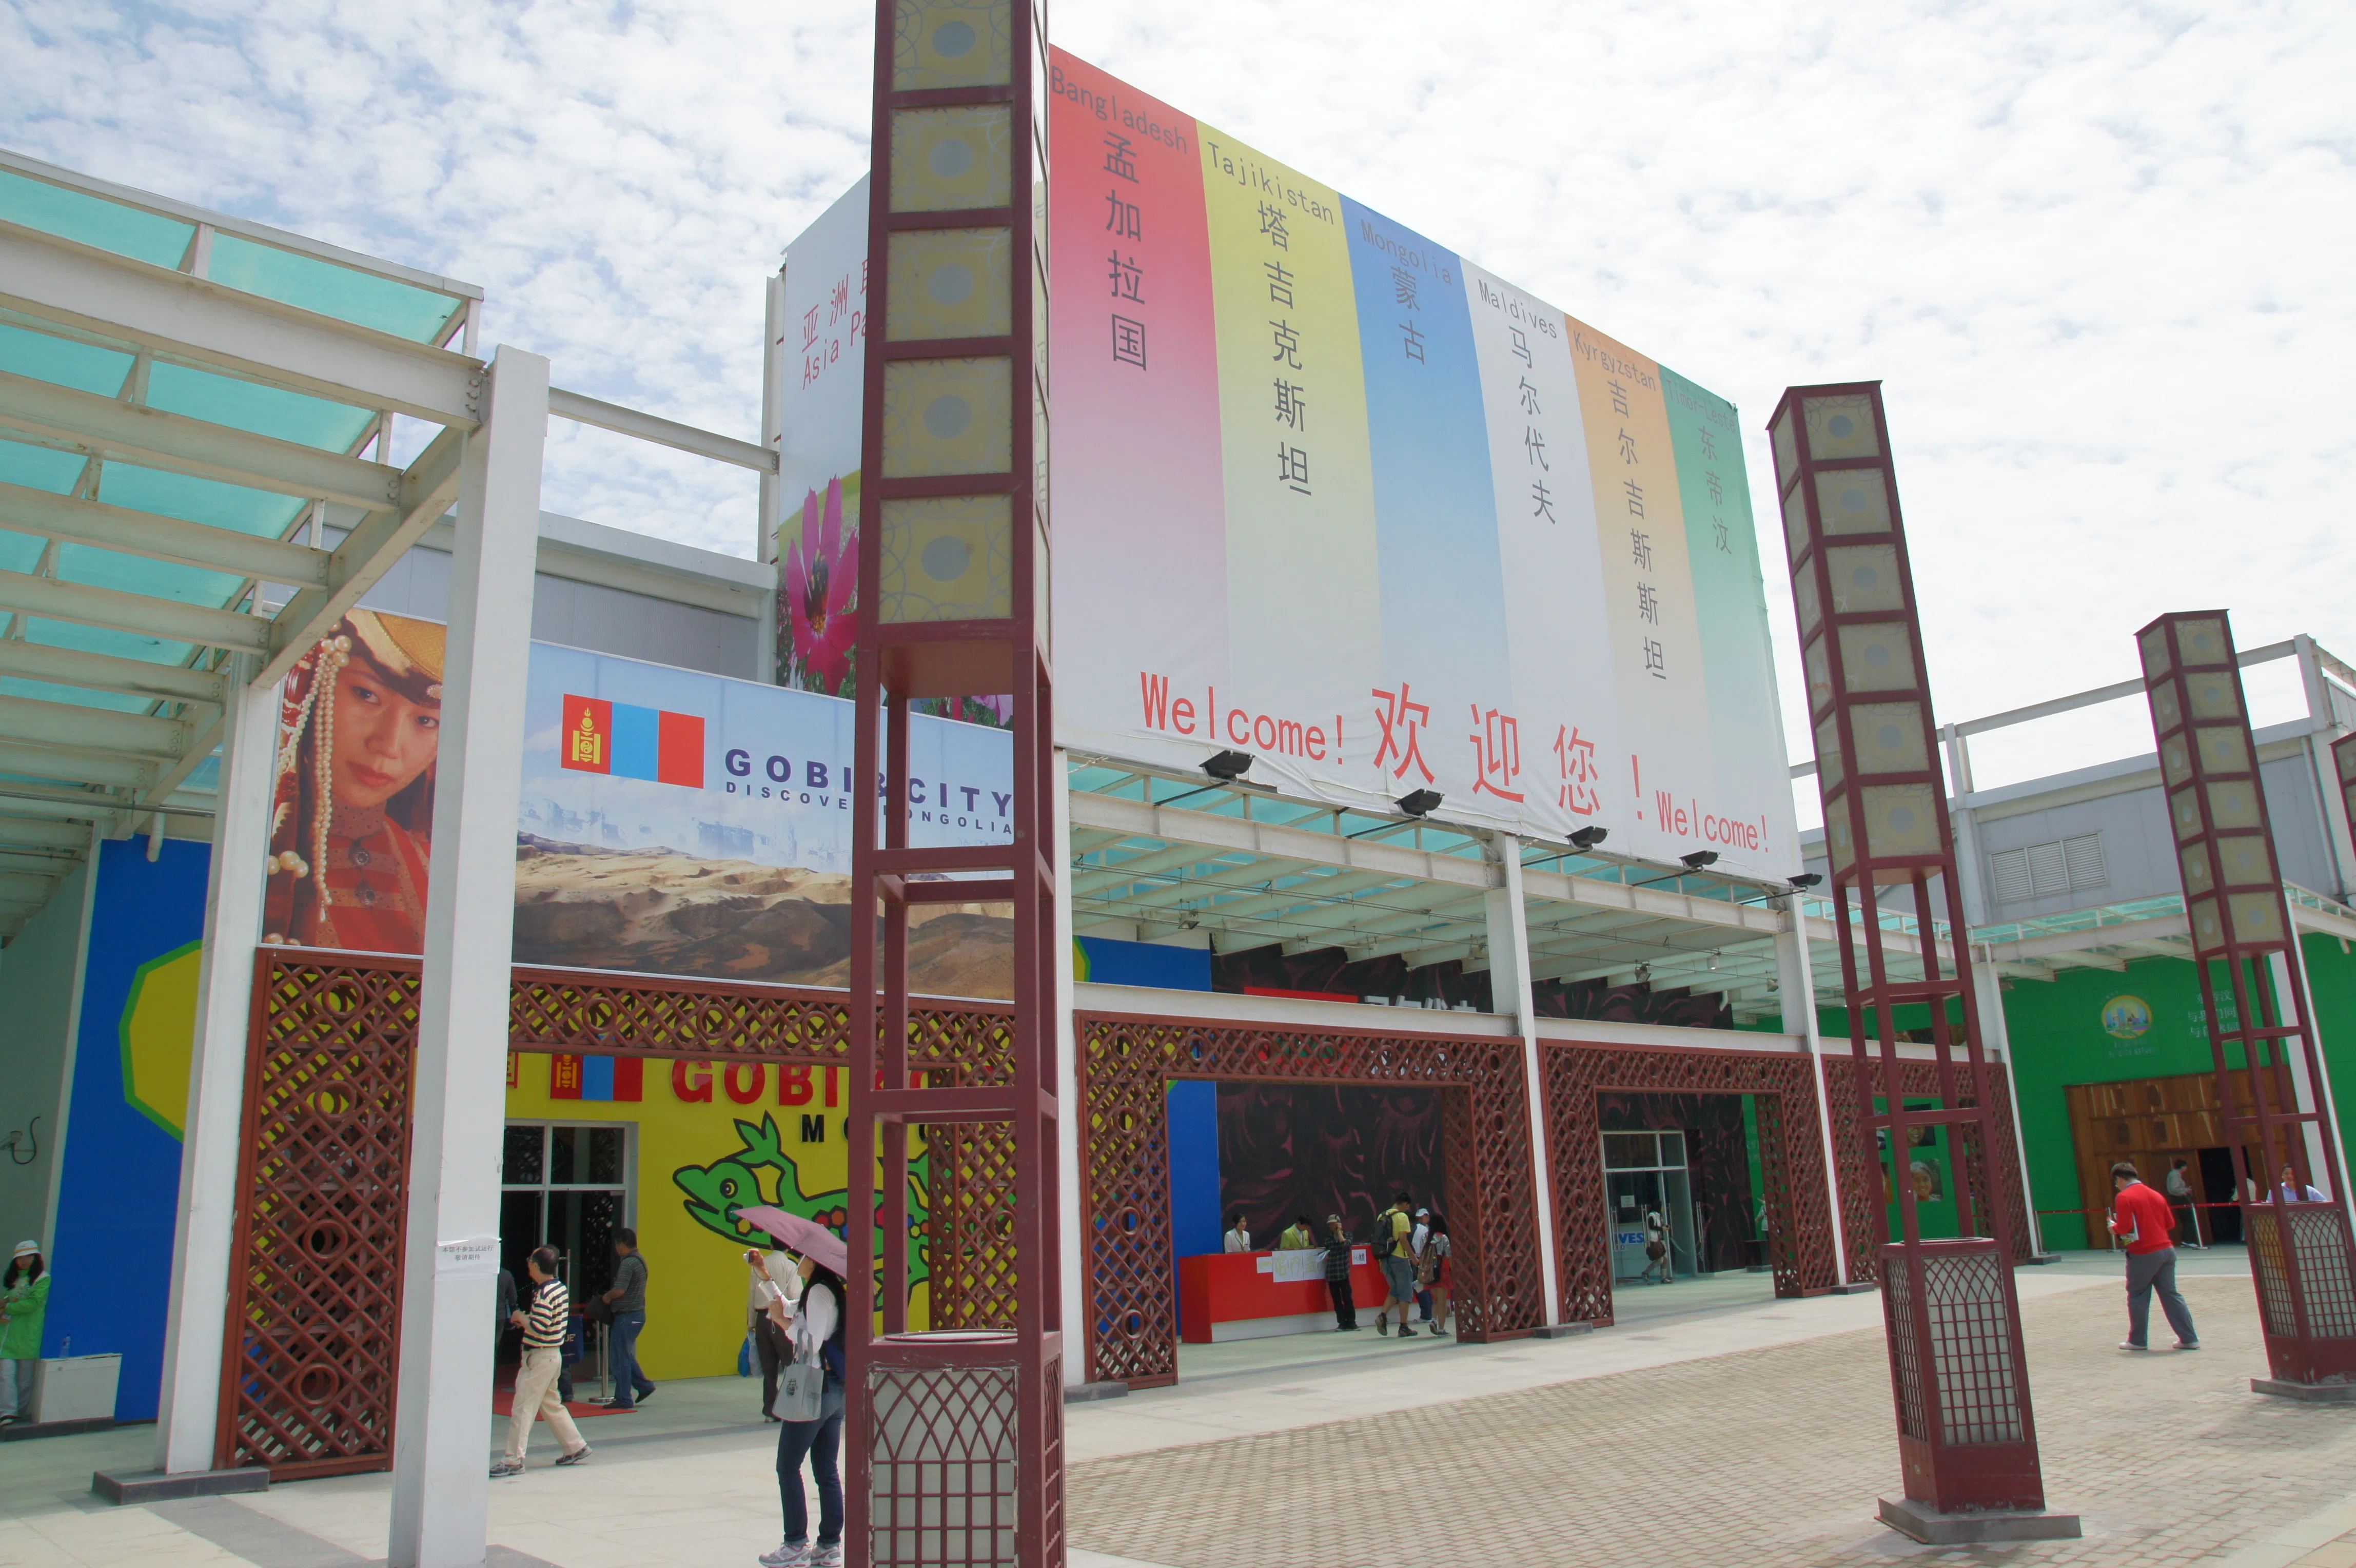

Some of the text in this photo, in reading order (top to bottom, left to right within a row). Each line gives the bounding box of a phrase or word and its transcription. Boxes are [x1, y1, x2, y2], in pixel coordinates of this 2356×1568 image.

[1051, 66, 1187, 154] Bangladesh
[1207, 142, 1334, 225] Tajikistan
[1103, 131, 1147, 371] 孟加拉国
[1361, 219, 1452, 285] Mongolia
[1258, 200, 1312, 496] 塔吉克斯坦
[1391, 266, 1425, 366] 蒙古
[1479, 279, 1558, 339] Maldives
[803, 339, 839, 390] Asia
[1573, 330, 1657, 392] Kyrgyzstan
[1509, 325, 1557, 525] 马尔代夫
[1666, 379, 1736, 433] Timor-Leste
[1607, 379, 1667, 680] 吉尔吉斯斯坦
[1698, 424, 1732, 555] 东帝汶
[725, 749, 852, 793] GOBI
[909, 777, 1012, 817] CITY
[1140, 671, 1343, 766] Welcome!
[1656, 790, 1769, 853] Welcome!
[726, 781, 1012, 834] DISCOVE NGOLIA
[672, 1059, 838, 1107] GOBI
